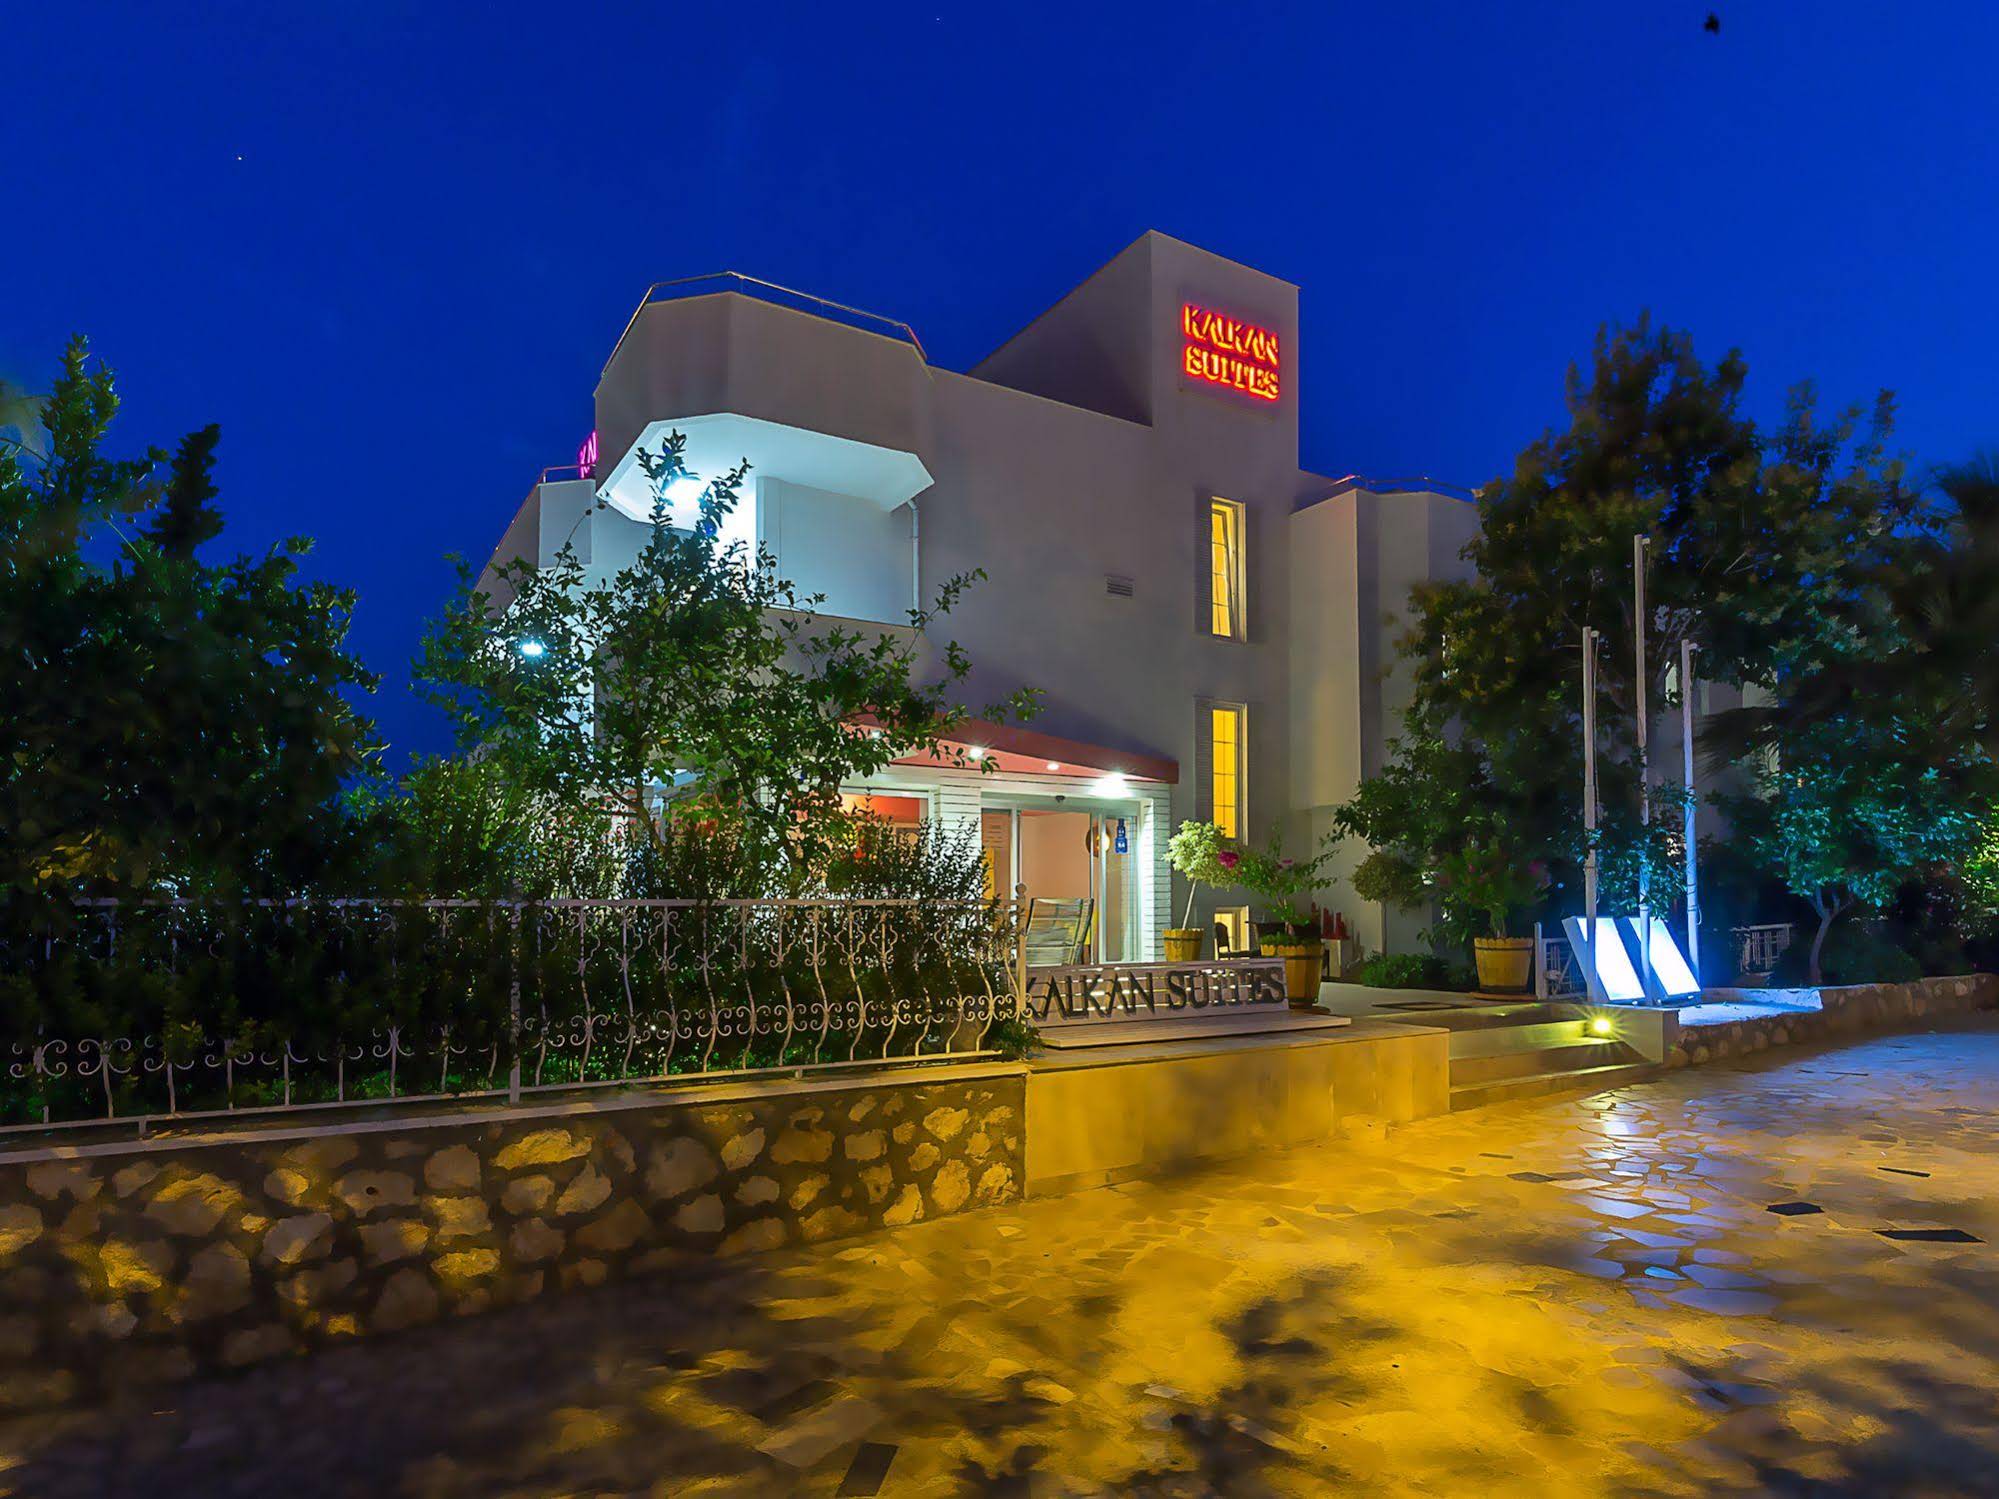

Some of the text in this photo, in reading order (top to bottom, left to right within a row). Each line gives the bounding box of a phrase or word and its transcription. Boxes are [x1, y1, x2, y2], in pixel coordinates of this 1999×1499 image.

[1184, 304, 1279, 366] KALKAN
[1184, 345, 1280, 401] SUITES
[1166, 966, 1286, 1010] SUITES
